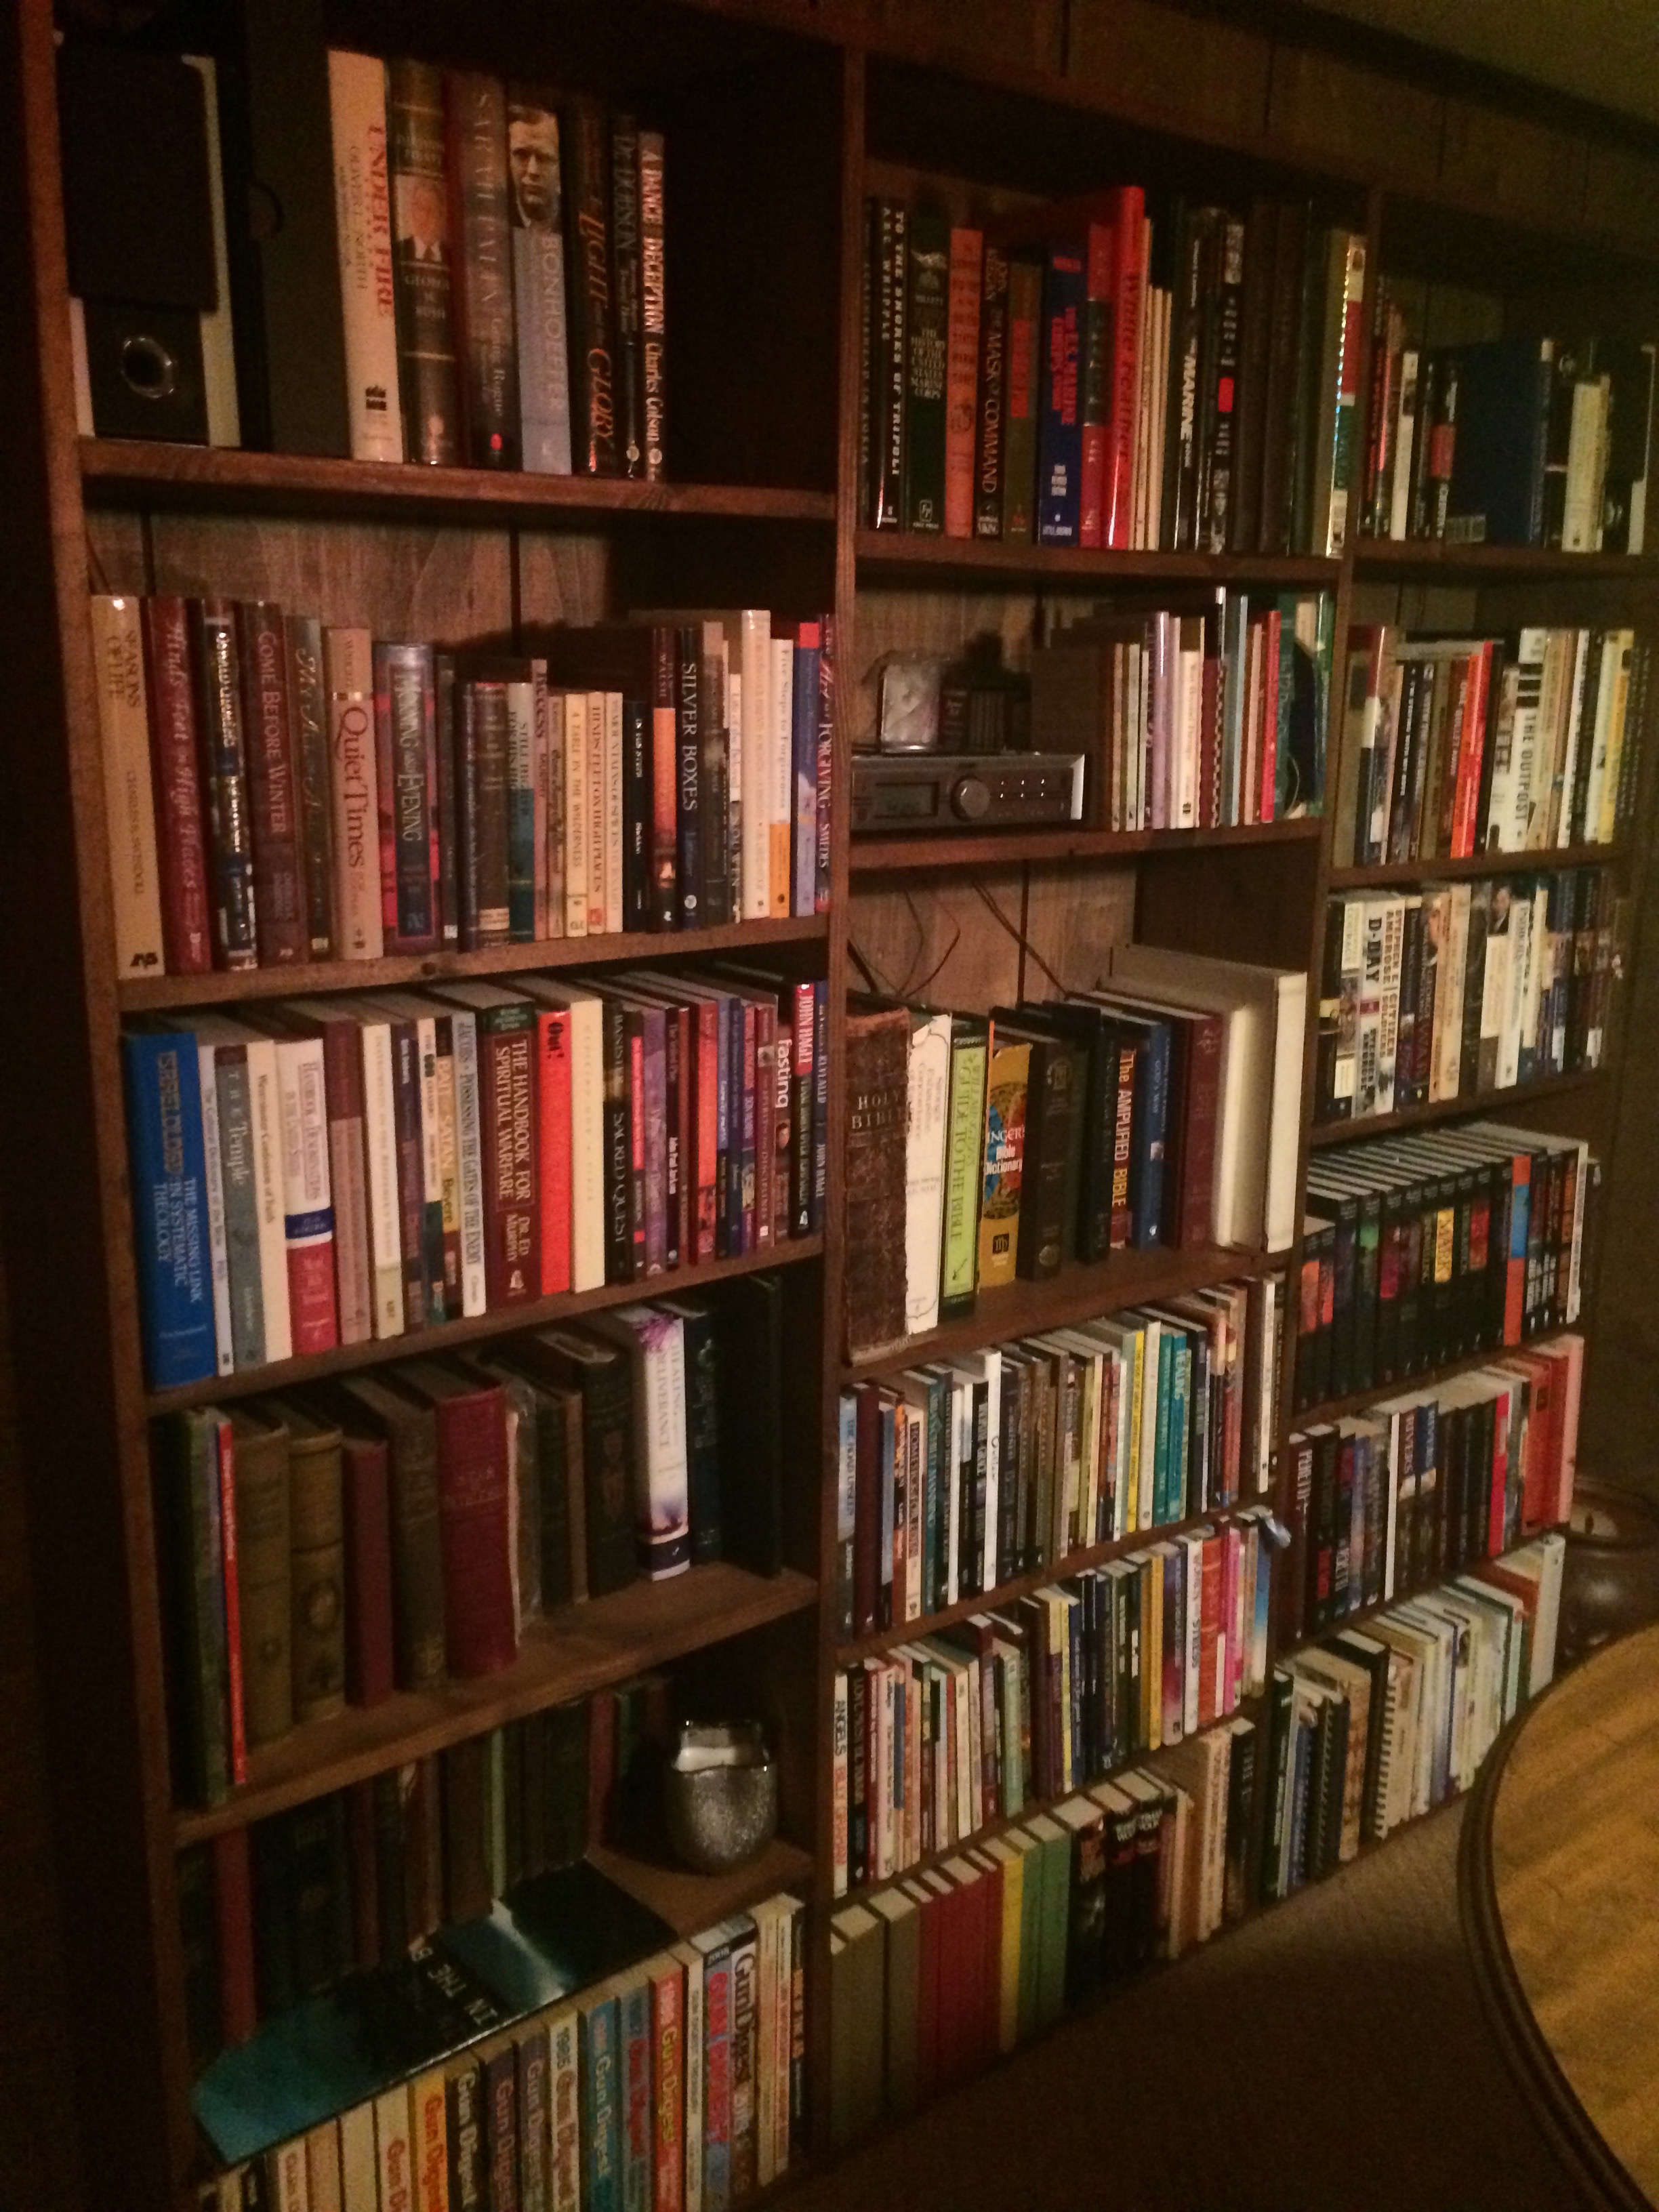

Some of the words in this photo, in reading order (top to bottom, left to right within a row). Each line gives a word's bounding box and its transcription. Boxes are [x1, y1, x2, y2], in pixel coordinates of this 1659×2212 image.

[369, 125, 390, 235] UNDER
[644, 169, 663, 223] DANCE
[894, 211, 905, 233] TO
[375, 249, 394, 316] FIRE
[644, 237, 664, 335] DECEPTION
[894, 243, 904, 278] THE
[542, 236, 565, 412] BONHOEFFER
[893, 287, 903, 364] SHORES
[644, 342, 663, 393] Charles
[893, 373, 902, 395] OF
[985, 331, 1002, 382] MASK
[645, 397, 662, 441] Colson
[1181, 356, 1197, 442] MARINE
[892, 402, 901, 475] TRIPOLI
[982, 399, 1000, 493] COMMAND
[257, 631, 278, 684] COME
[261, 691, 281, 758] BEFORE
[394, 671, 423, 747] MORNING
[680, 662, 698, 737] SILVER
[335, 707, 369, 783] Quiet
[1522, 714, 1538, 743] THE
[681, 745, 698, 811] BOXES
[817, 722, 834, 808] FORGIVING
[1515, 750, 1534, 820] OUTPOST
[265, 766, 287, 833] WINTER
[342, 785, 369, 867] Times
[397, 773, 426, 842] EVENING
[1365, 918, 1384, 983] D-DAY
[798, 995, 814, 1026] JOHN
[511, 1040, 529, 1070] THE
[546, 1021, 565, 1059] Out!
[1119, 1054, 1135, 1083] The
[495, 1046, 513, 1125] SPIRITUAL
[774, 1038, 793, 1109] fasting
[857, 1089, 901, 1111] HOLY
[956, 1066, 972, 1124] GUIDE
[512, 1074, 531, 1164] HANDBOOK
[613, 1112, 626, 1180] SACRED
[954, 1126, 968, 1154] TO
[1114, 1089, 1133, 1162] AMPLIFIED
[462, 1138, 477, 1158] THE
[497, 1128, 515, 1200] WARFARE
[952, 1154, 966, 1192] THE
[985, 1158, 1023, 1176] Dictionary
[169, 1182, 184, 1199] IN
[185, 1178, 198, 1204] THE
[516, 1170, 531, 1201] FOR
[612, 1184, 626, 1244] QUEST
[1111, 1167, 1128, 1208] BIBLE
[153, 1182, 172, 1263] THEOLOGY
[169, 1202, 188, 1286] SYSTEMATIC
[186, 1208, 201, 1266] MISSING
[464, 1208, 480, 1229] THE
[950, 1195, 965, 1241] BIBLE
[1436, 1218, 1453, 1275] MARK
[189, 1267, 203, 1303] LINK
[834, 1700, 847, 1757] ANGELS
[735, 1953, 756, 2008] Gun
[661, 2025, 678, 2074] Gun
[457, 2072, 476, 2126] Gun
[495, 2078, 514, 2133] Gun
[527, 2060, 544, 2110] Gun
[596, 2053, 612, 2105] Gun
[658, 2075, 678, 2143] Digest
[387, 2139, 407, 2190] Gun
[457, 2125, 478, 2209] Digest
[594, 2105, 613, 2178] Digest
